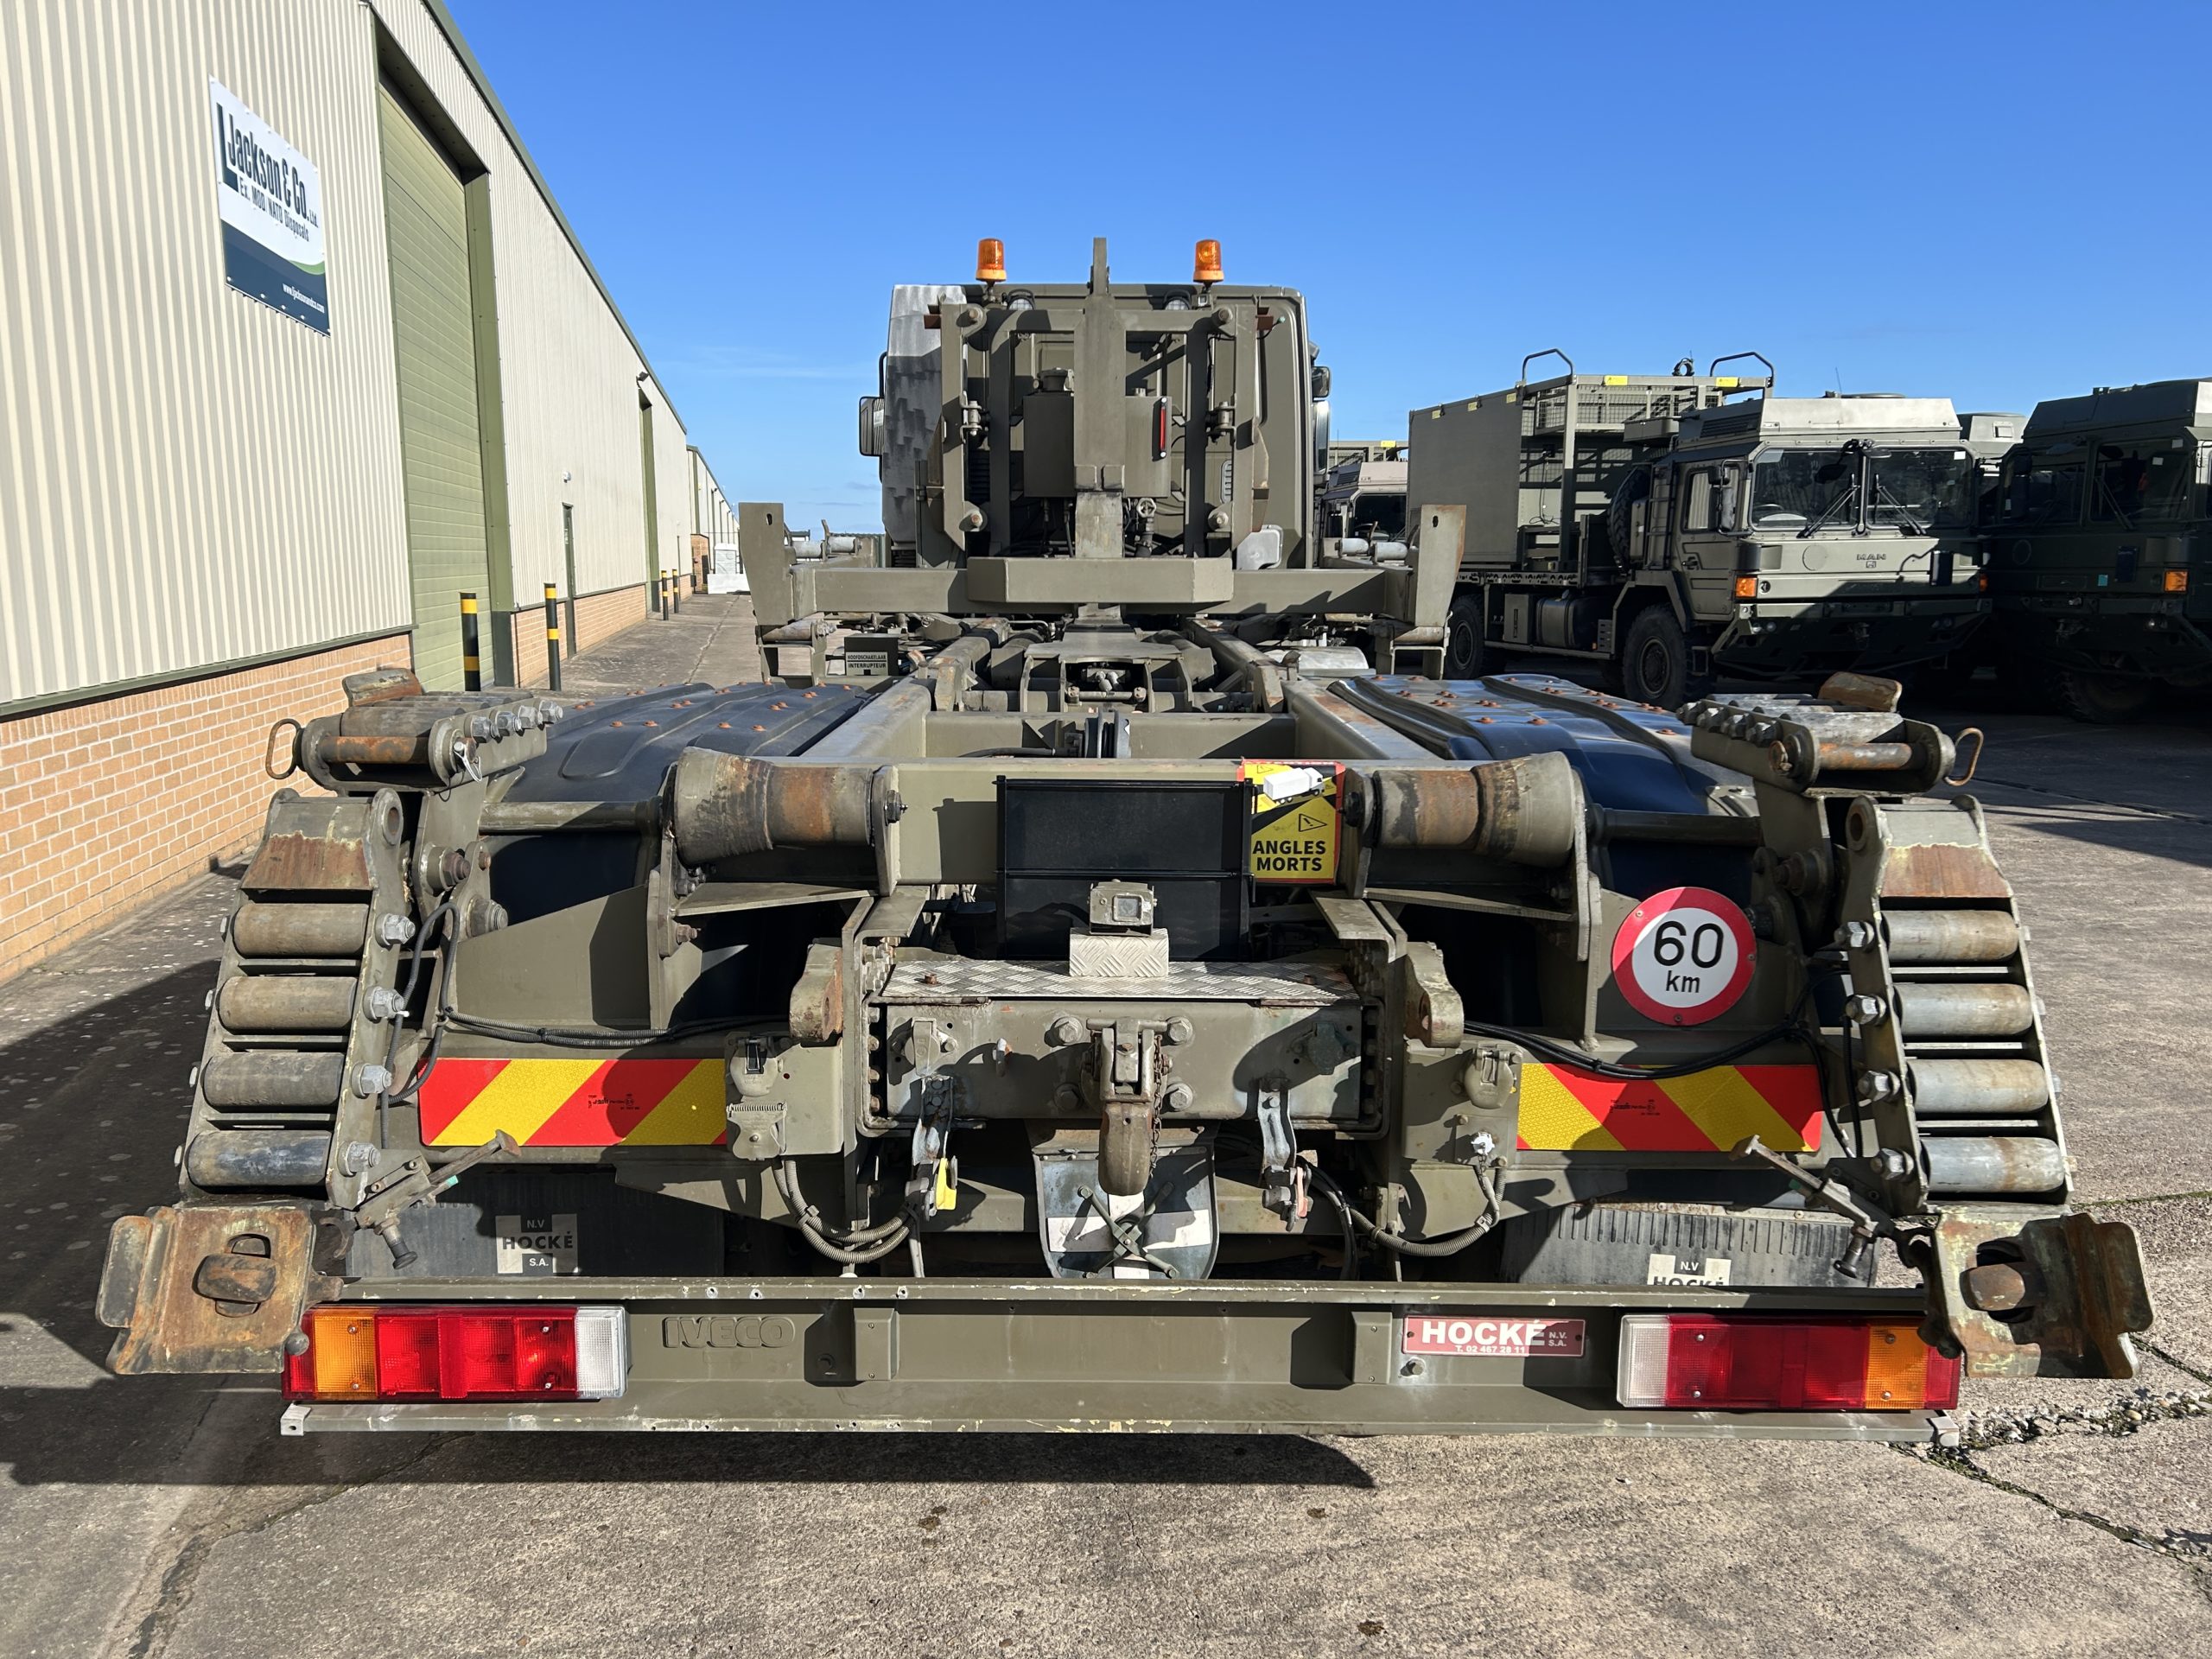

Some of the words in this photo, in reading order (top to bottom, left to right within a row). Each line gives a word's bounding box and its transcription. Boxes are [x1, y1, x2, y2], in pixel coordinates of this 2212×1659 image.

[227, 113, 282, 202] Jackson
[282, 158, 291, 207] &
[292, 166, 309, 222] Co.
[283, 209, 309, 242] Disposals
[1252, 840, 1326, 855] ANGLES
[1256, 856, 1323, 872] MORTS
[1653, 920, 1725, 969] 60
[1665, 969, 1700, 994] km
[502, 1231, 573, 1250] HOCKÉ
[529, 1257, 550, 1267] S.A.
[662, 1315, 796, 1348] IVECO
[1479, 1345, 1497, 1354] 467
[1499, 1345, 1512, 1354] 28
